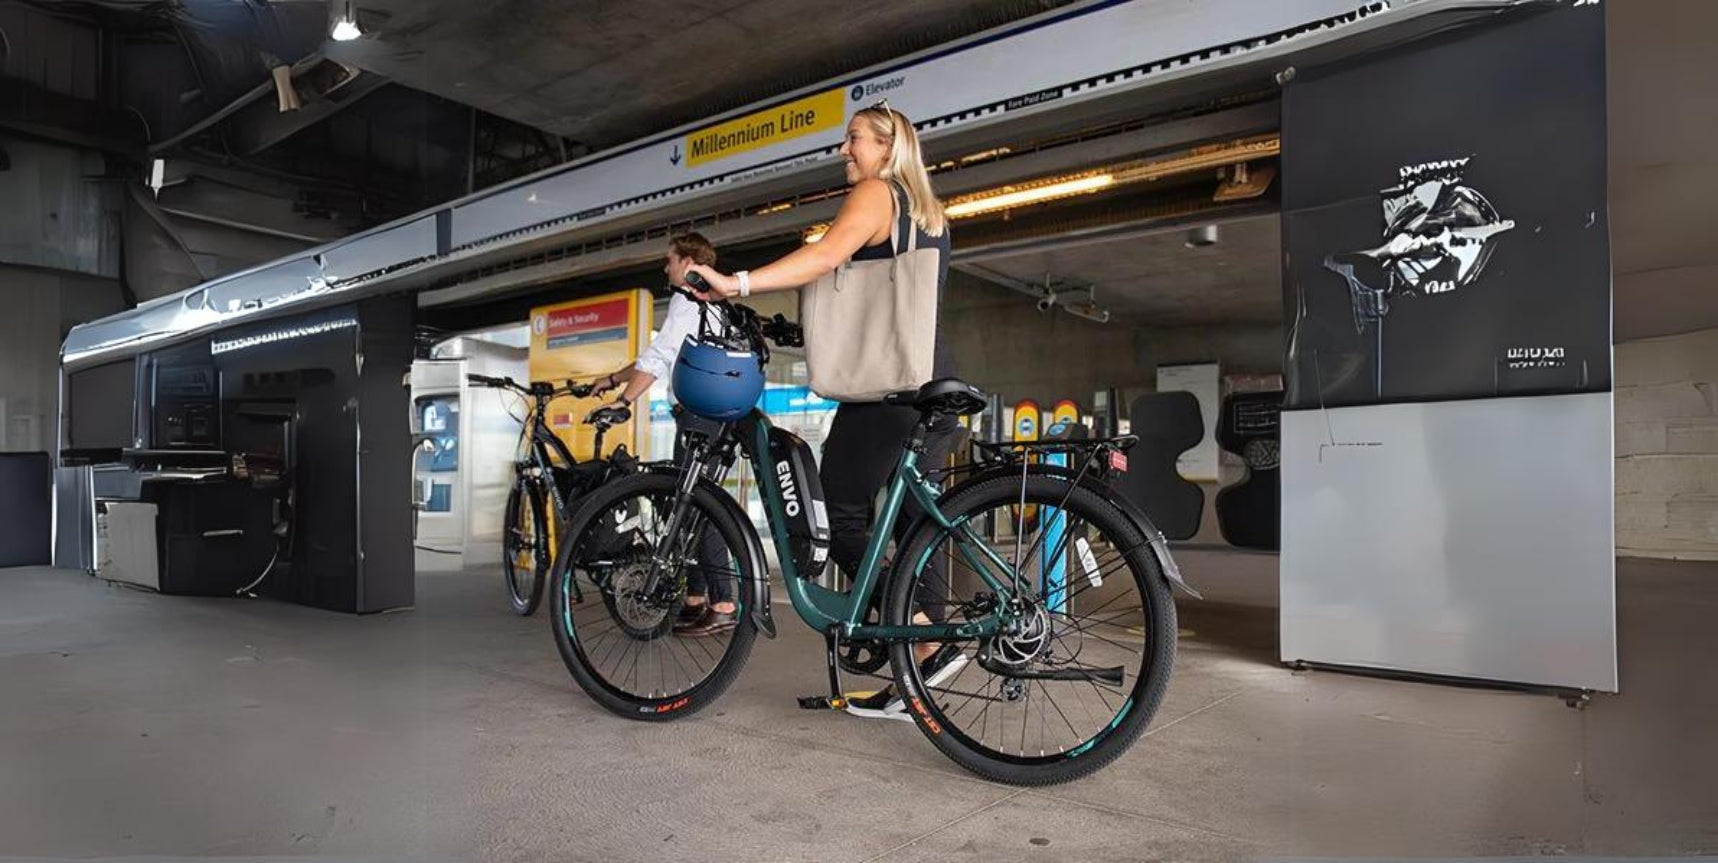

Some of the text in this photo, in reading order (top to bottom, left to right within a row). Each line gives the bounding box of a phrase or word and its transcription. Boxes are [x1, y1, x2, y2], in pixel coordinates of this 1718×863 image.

[866, 76, 905, 96] Elevator
[1024, 93, 1040, 105] Paid
[1041, 91, 1058, 101] Zone
[692, 110, 816, 159] Millennium Line
[574, 312, 599, 323] Security
[776, 460, 800, 517] ENVO
